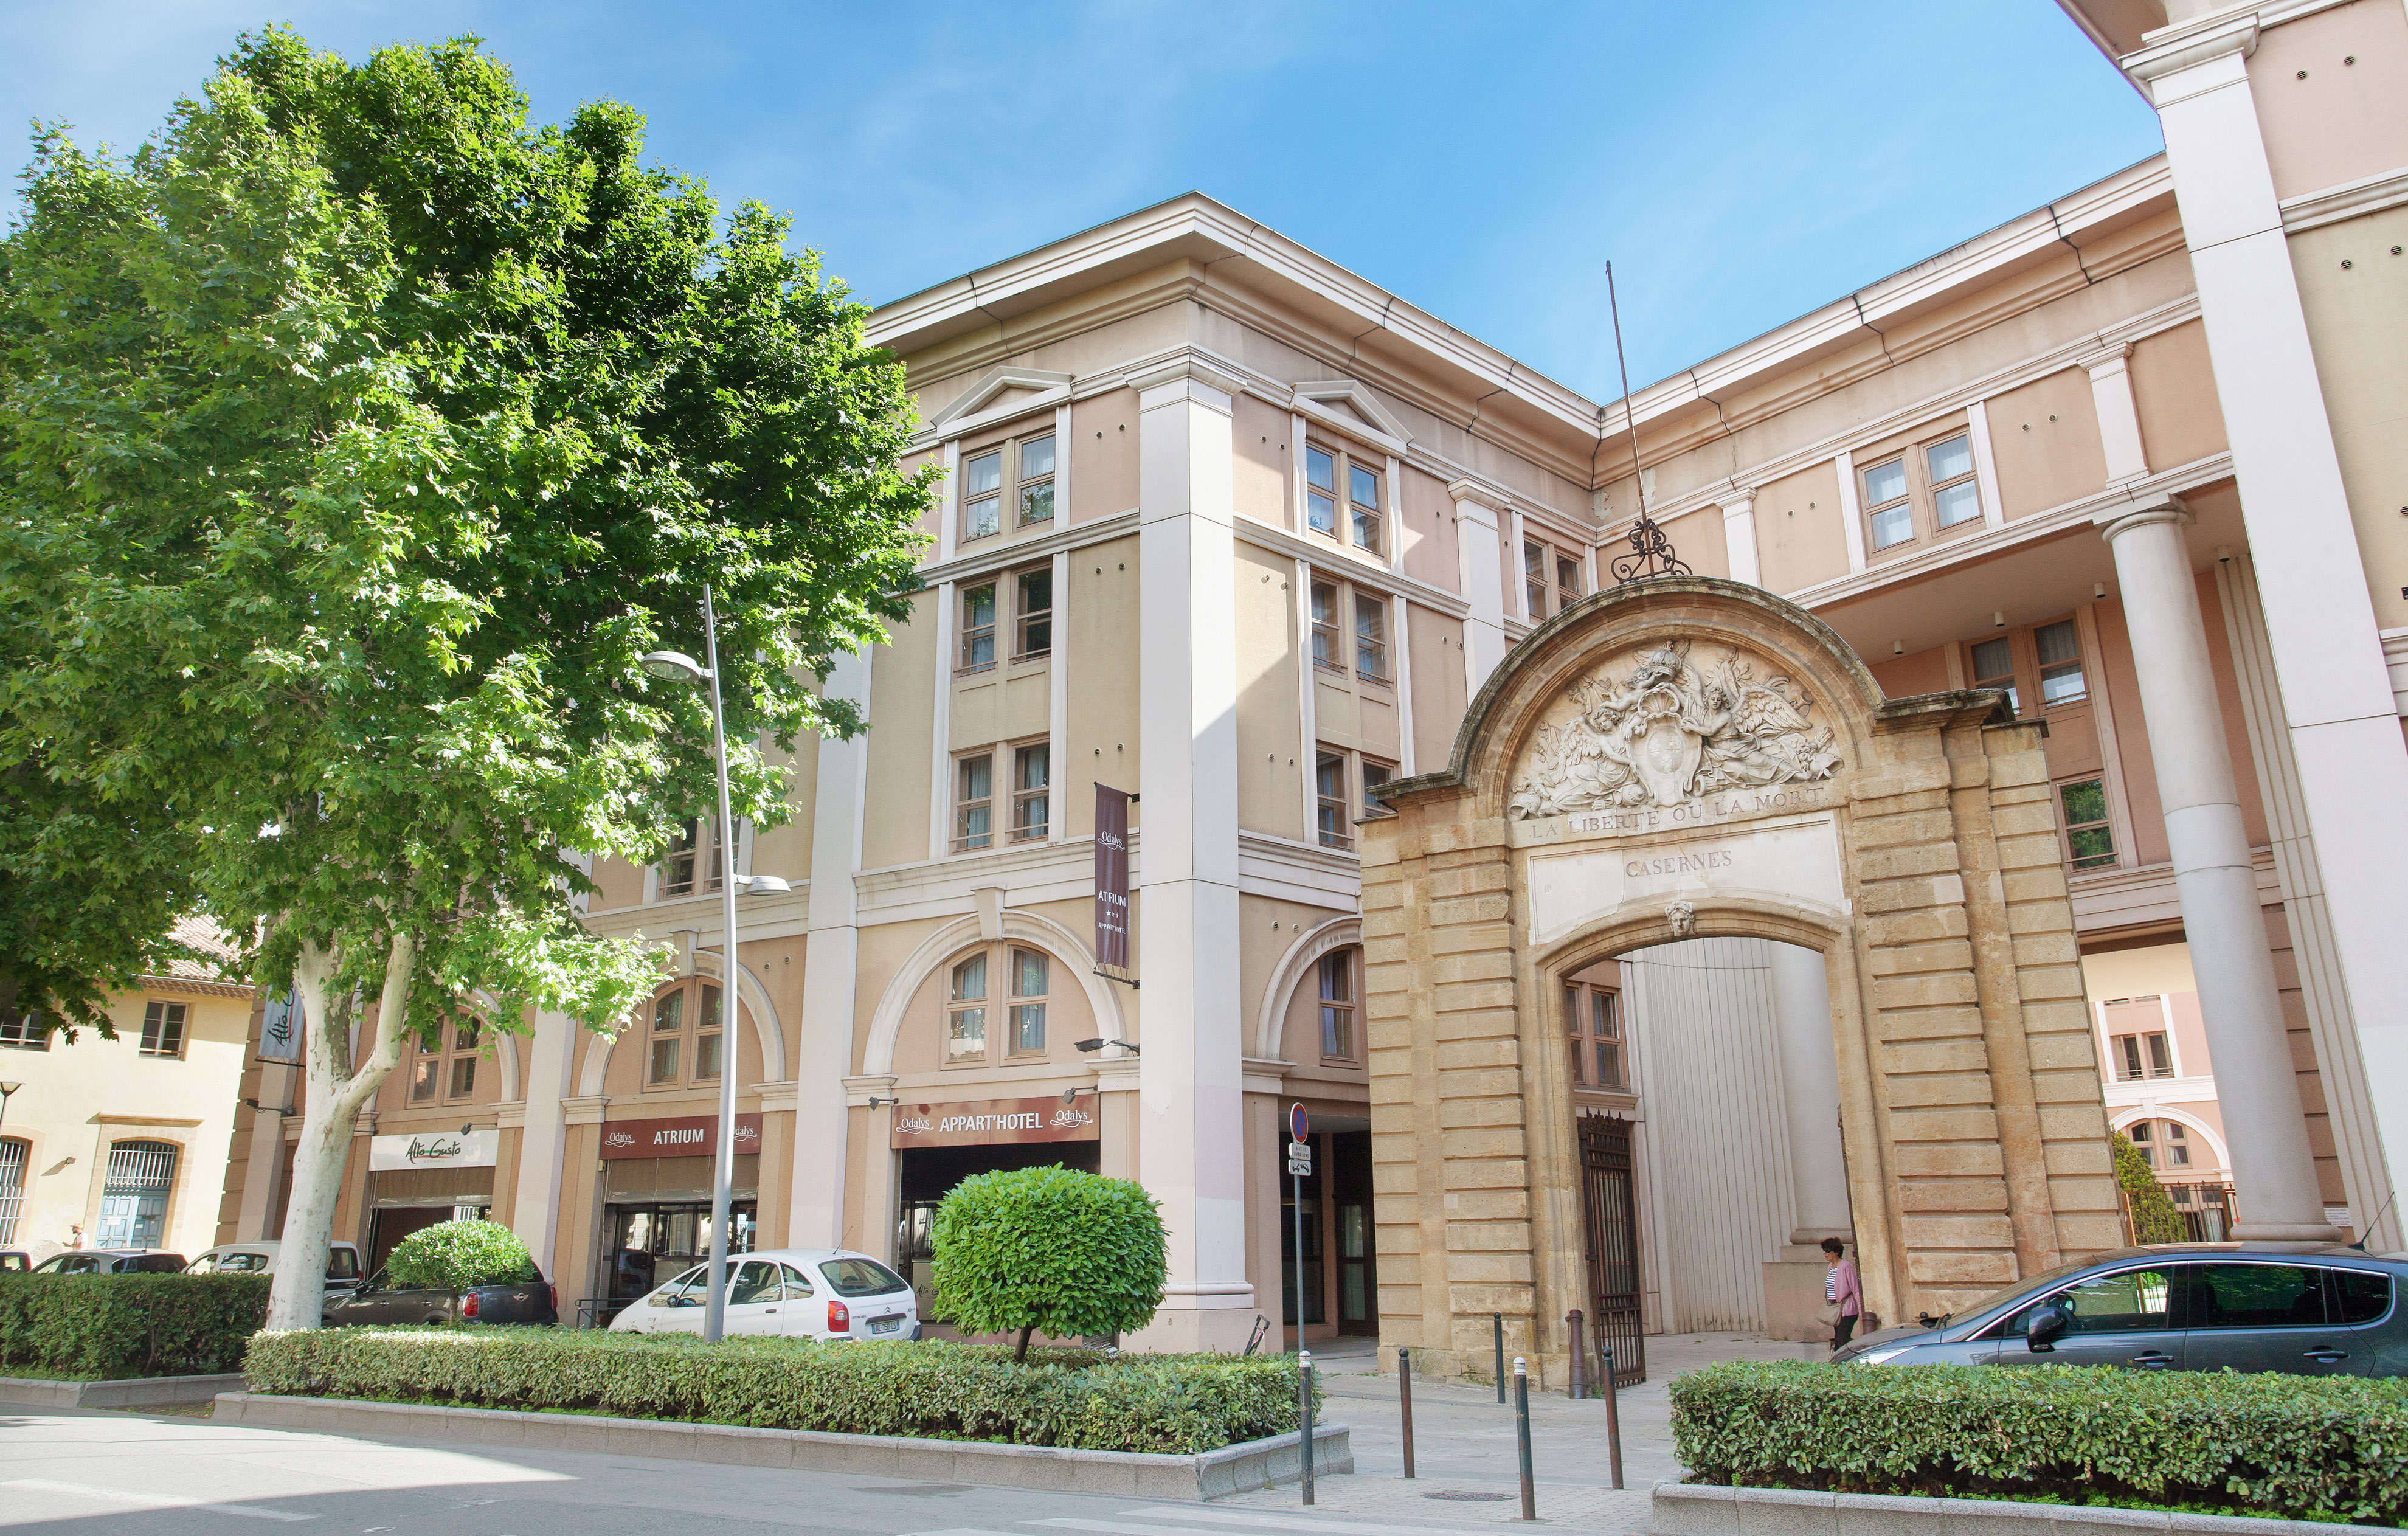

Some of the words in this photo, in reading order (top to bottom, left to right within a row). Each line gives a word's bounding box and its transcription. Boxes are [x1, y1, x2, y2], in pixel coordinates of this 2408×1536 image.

[1532, 824, 1558, 839] LA
[1568, 811, 1660, 834] LIBERTE
[1673, 804, 1702, 821] OU
[1715, 800, 1744, 815] LA
[1755, 787, 1824, 812] MORT
[1102, 831, 1123, 850] Odalys
[1625, 850, 1732, 877] CASERNES
[1098, 890, 1126, 907] ATRIUM
[268, 1015, 294, 1047] Alto
[901, 1118, 930, 1134] Odalys
[939, 1113, 1043, 1132] APPART'HOTEL
[1055, 1109, 1088, 1127] Odalys
[609, 1132, 632, 1147] Odalys
[653, 1129, 704, 1144] ATRIUM
[734, 1126, 754, 1141] dalys
[405, 1137, 425, 1164] Alto
[429, 1138, 461, 1158] Gusto
[916, 1283, 929, 1298] Alto
